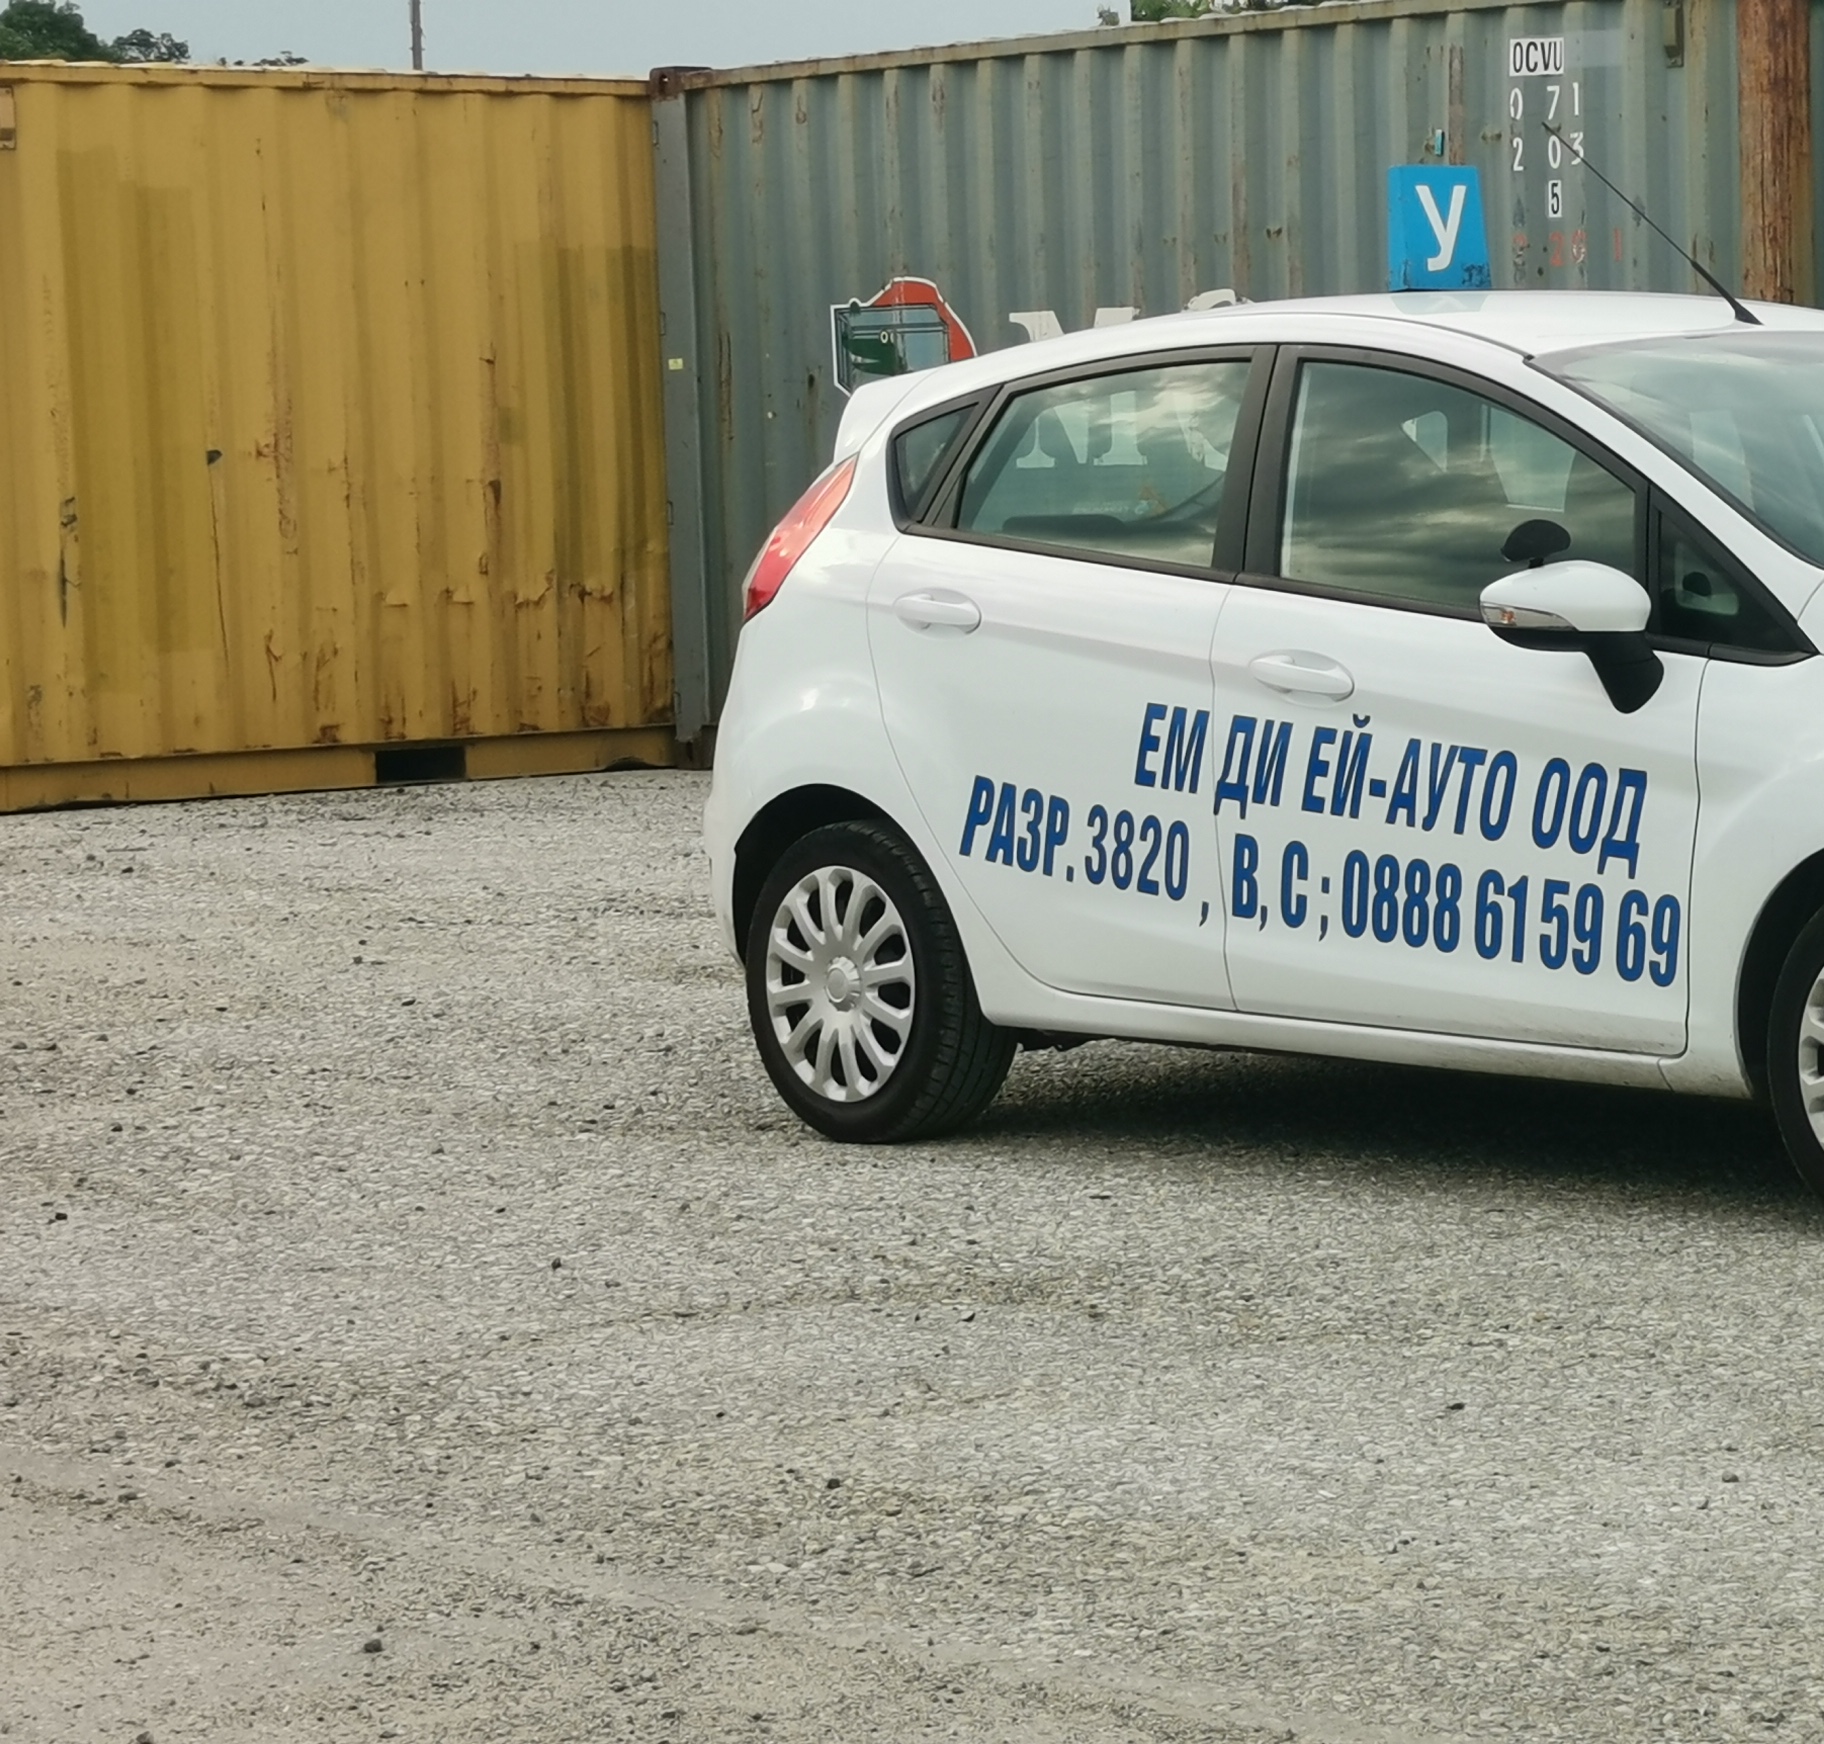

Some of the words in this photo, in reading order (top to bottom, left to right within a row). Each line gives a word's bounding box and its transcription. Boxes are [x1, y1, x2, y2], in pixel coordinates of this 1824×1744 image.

[1513, 40, 1562, 74] OCVU
[1415, 184, 1467, 272] У
[1551, 181, 1561, 215] 5
[1134, 702, 1210, 794] ЕМ
[1213, 714, 1294, 820] ДИ
[1301, 713, 1518, 842] ЕЙ-АУТО
[1532, 757, 1648, 880] ООД
[1341, 849, 1462, 954] 0888
